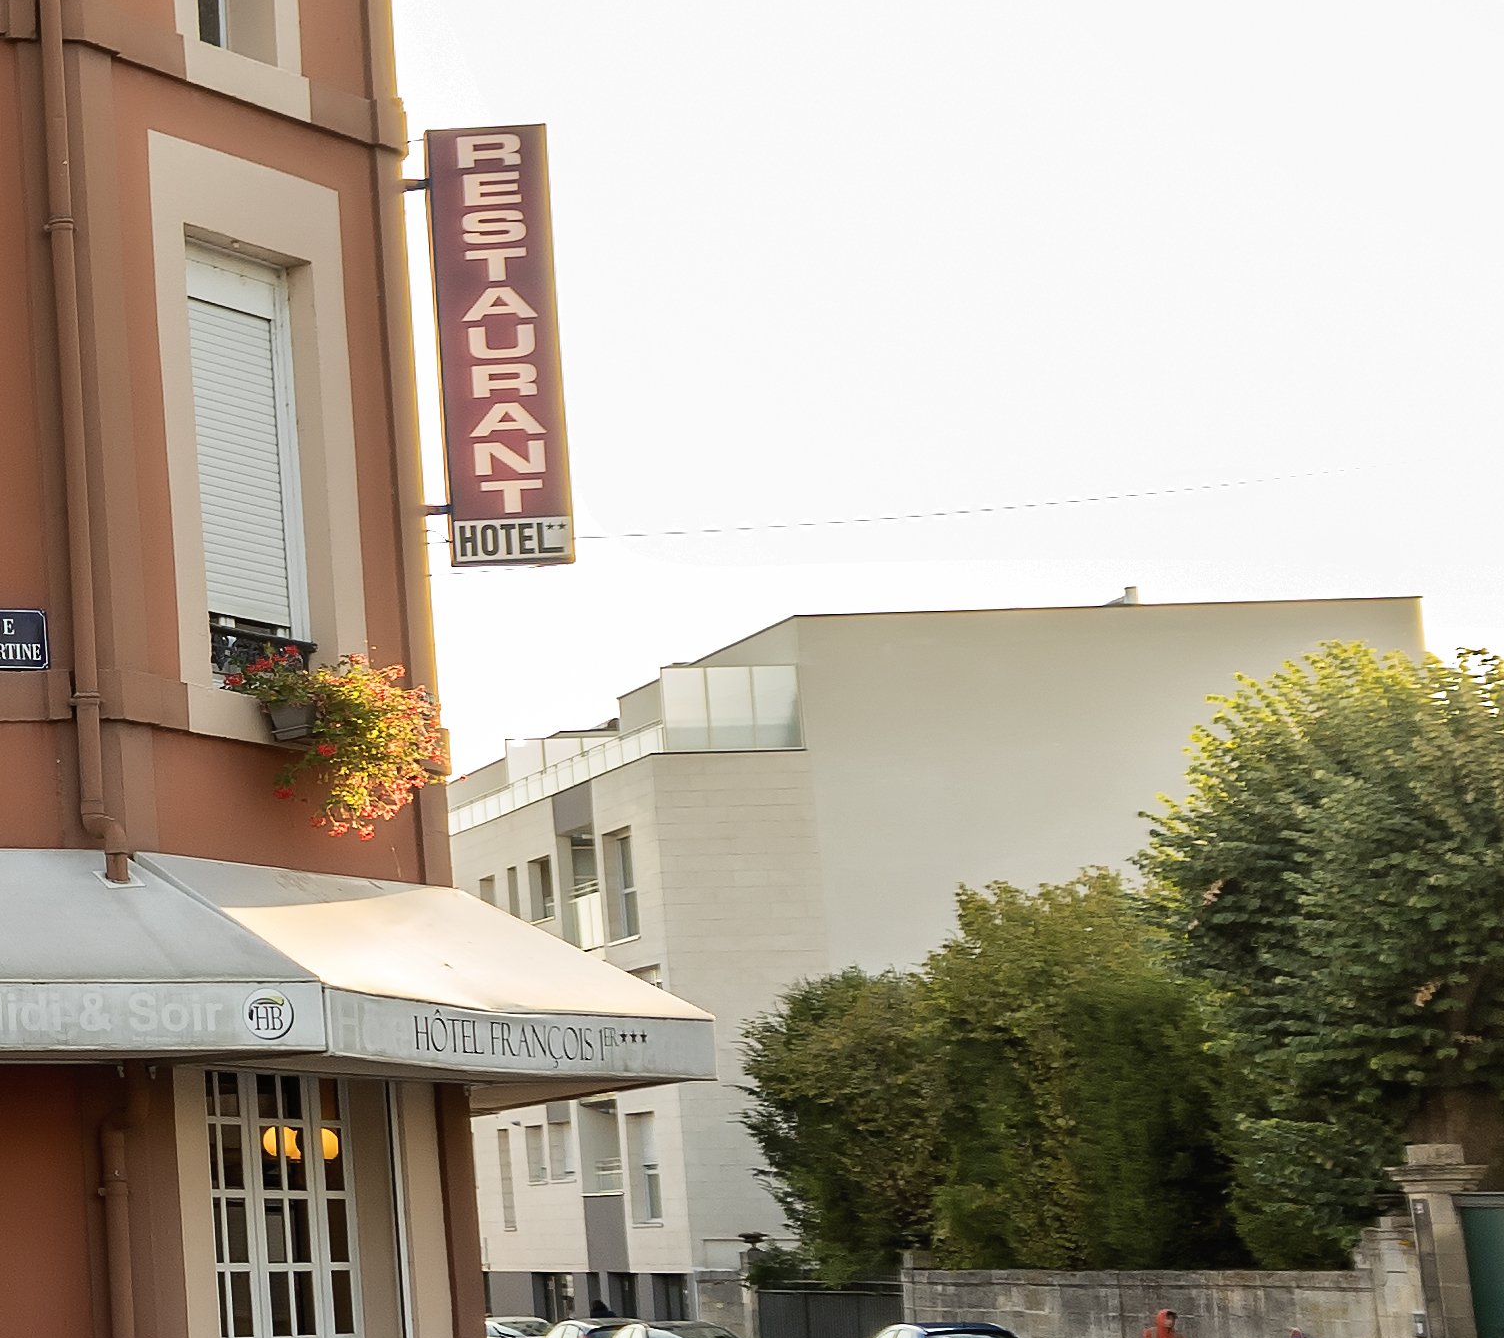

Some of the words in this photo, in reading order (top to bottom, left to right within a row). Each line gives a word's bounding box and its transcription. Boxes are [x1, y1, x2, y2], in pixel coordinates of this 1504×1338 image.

[455, 133, 548, 514] RESTAURANT
[459, 522, 565, 557] HOTEL
[413, 1009, 485, 1054] HÔTEL
[490, 1020, 593, 1067] FRANÇOIS
